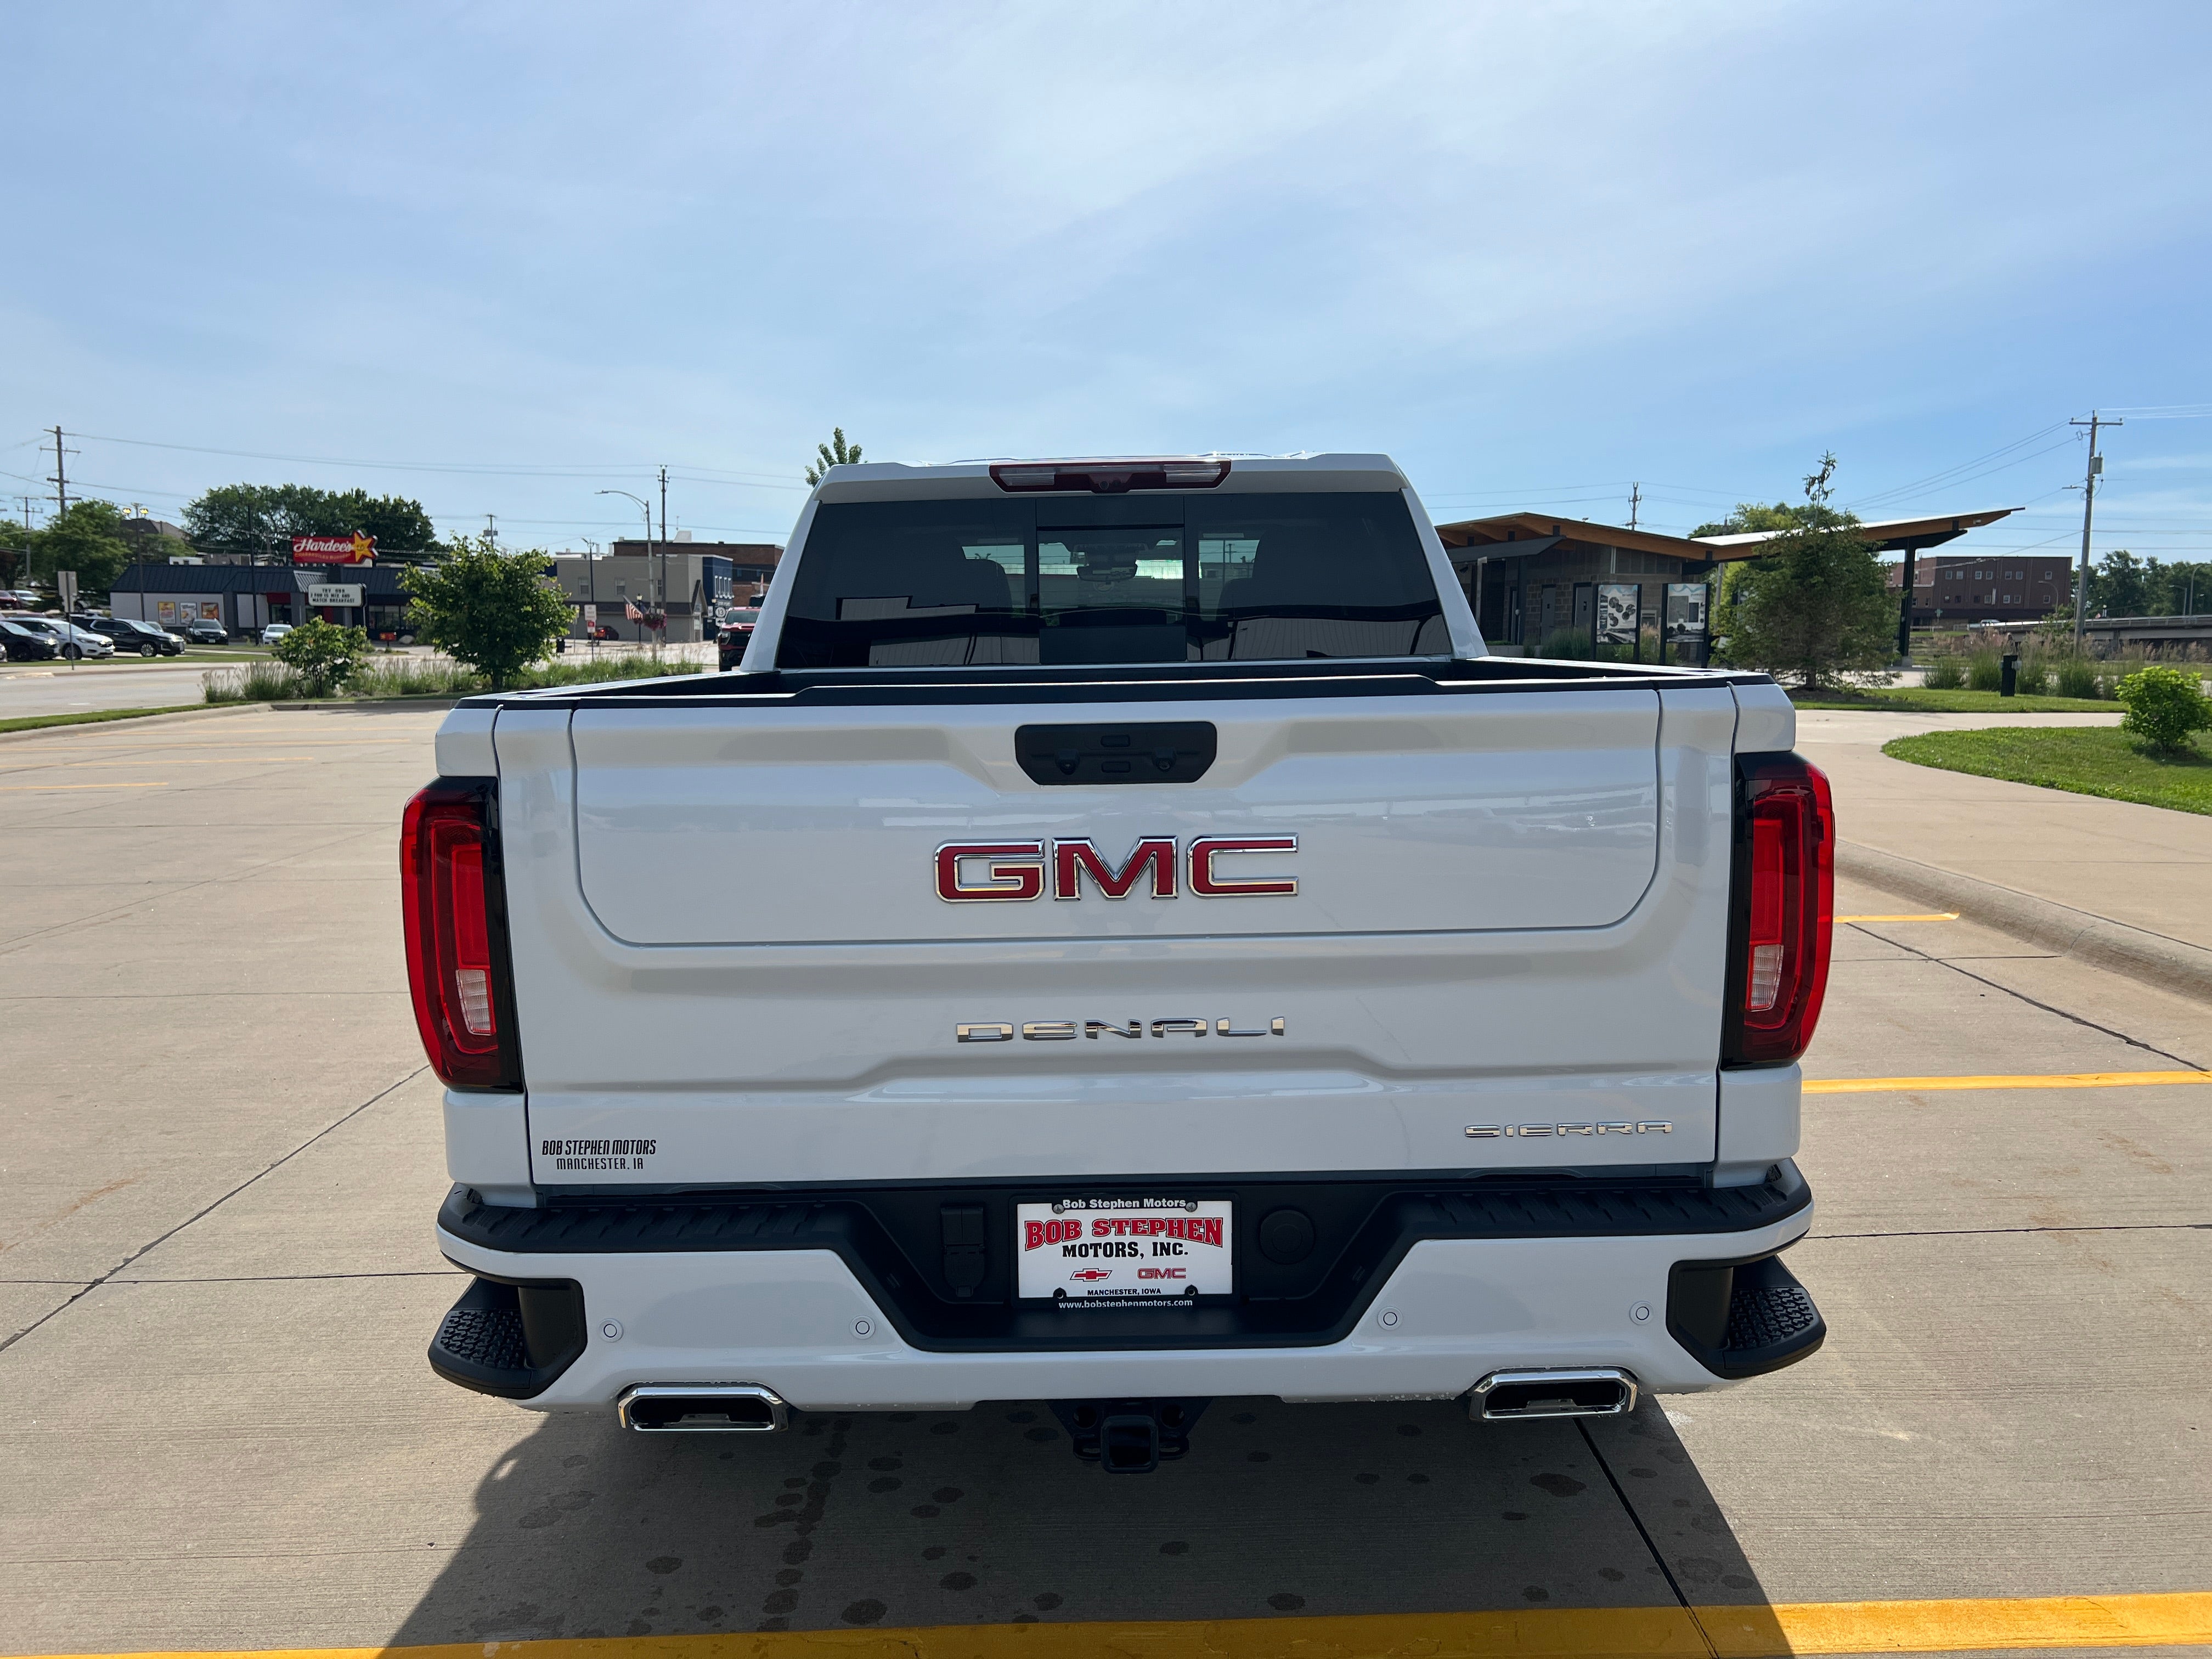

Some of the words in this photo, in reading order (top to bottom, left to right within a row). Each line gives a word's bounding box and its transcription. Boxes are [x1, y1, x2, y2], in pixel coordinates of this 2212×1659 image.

[293, 538, 353, 552] Hardee's
[934, 833, 1299, 903] GMC
[956, 1016, 1285, 1042] DENALI
[1464, 1120, 1673, 1137] SIERRA
[542, 1140, 563, 1155] BOB
[565, 1139, 610, 1155] STEPHEN
[612, 1139, 657, 1154] MOTORS
[634, 1158, 644, 1169] IA
[1063, 1199, 1086, 1209] Bob
[1090, 1199, 1139, 1209] Stephen
[1144, 1198, 1186, 1208] Motors
[1024, 1220, 1082, 1251] BOB
[1092, 1217, 1223, 1248] STEPHEN
[1062, 1242, 1144, 1260] MOTORS,
[1152, 1242, 1188, 1256] INC.
[1137, 1267, 1187, 1279] GMC
[1087, 1288, 1140, 1296] MANCHESTER,
[1058, 1299, 1193, 1308] www.bobstephenmotors.com
